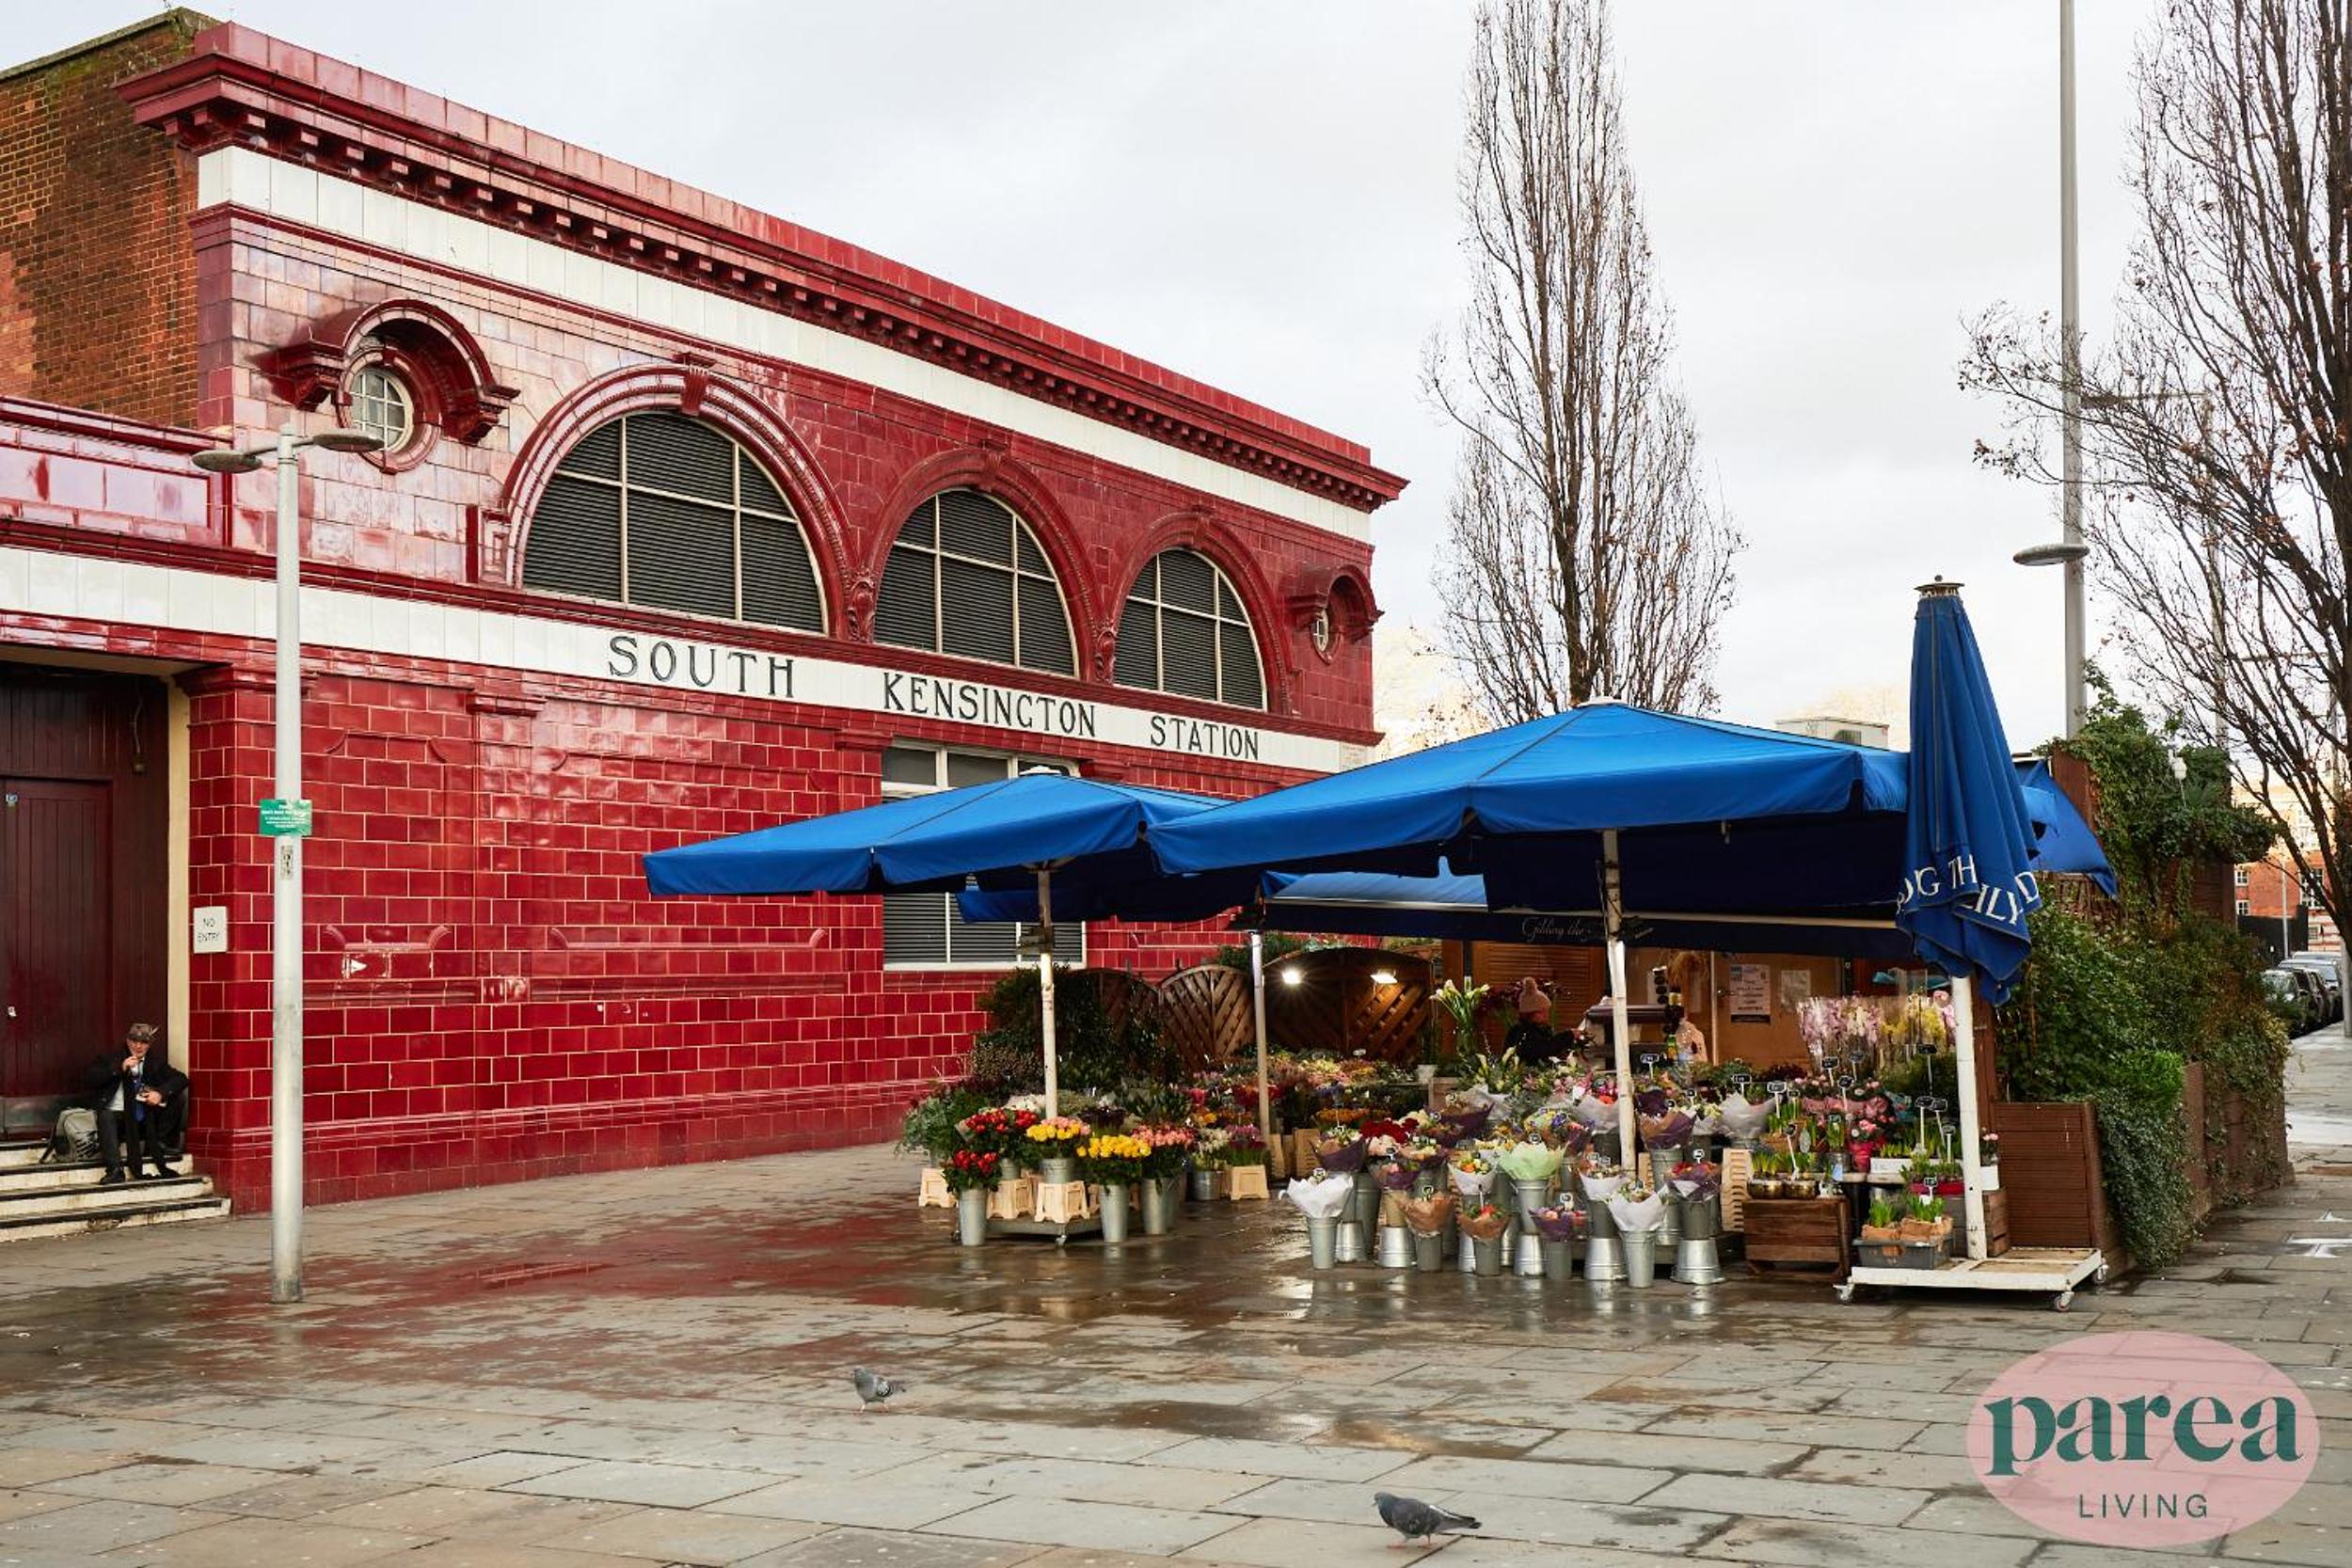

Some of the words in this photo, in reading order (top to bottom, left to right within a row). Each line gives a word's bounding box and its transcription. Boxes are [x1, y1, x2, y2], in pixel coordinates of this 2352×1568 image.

[608, 635, 794, 699] SOUTH
[882, 672, 1097, 737] KENSINGTON
[1150, 715, 1259, 760] STATION
[203, 917, 216, 927] NO
[198, 931, 220, 943] ENTRY
